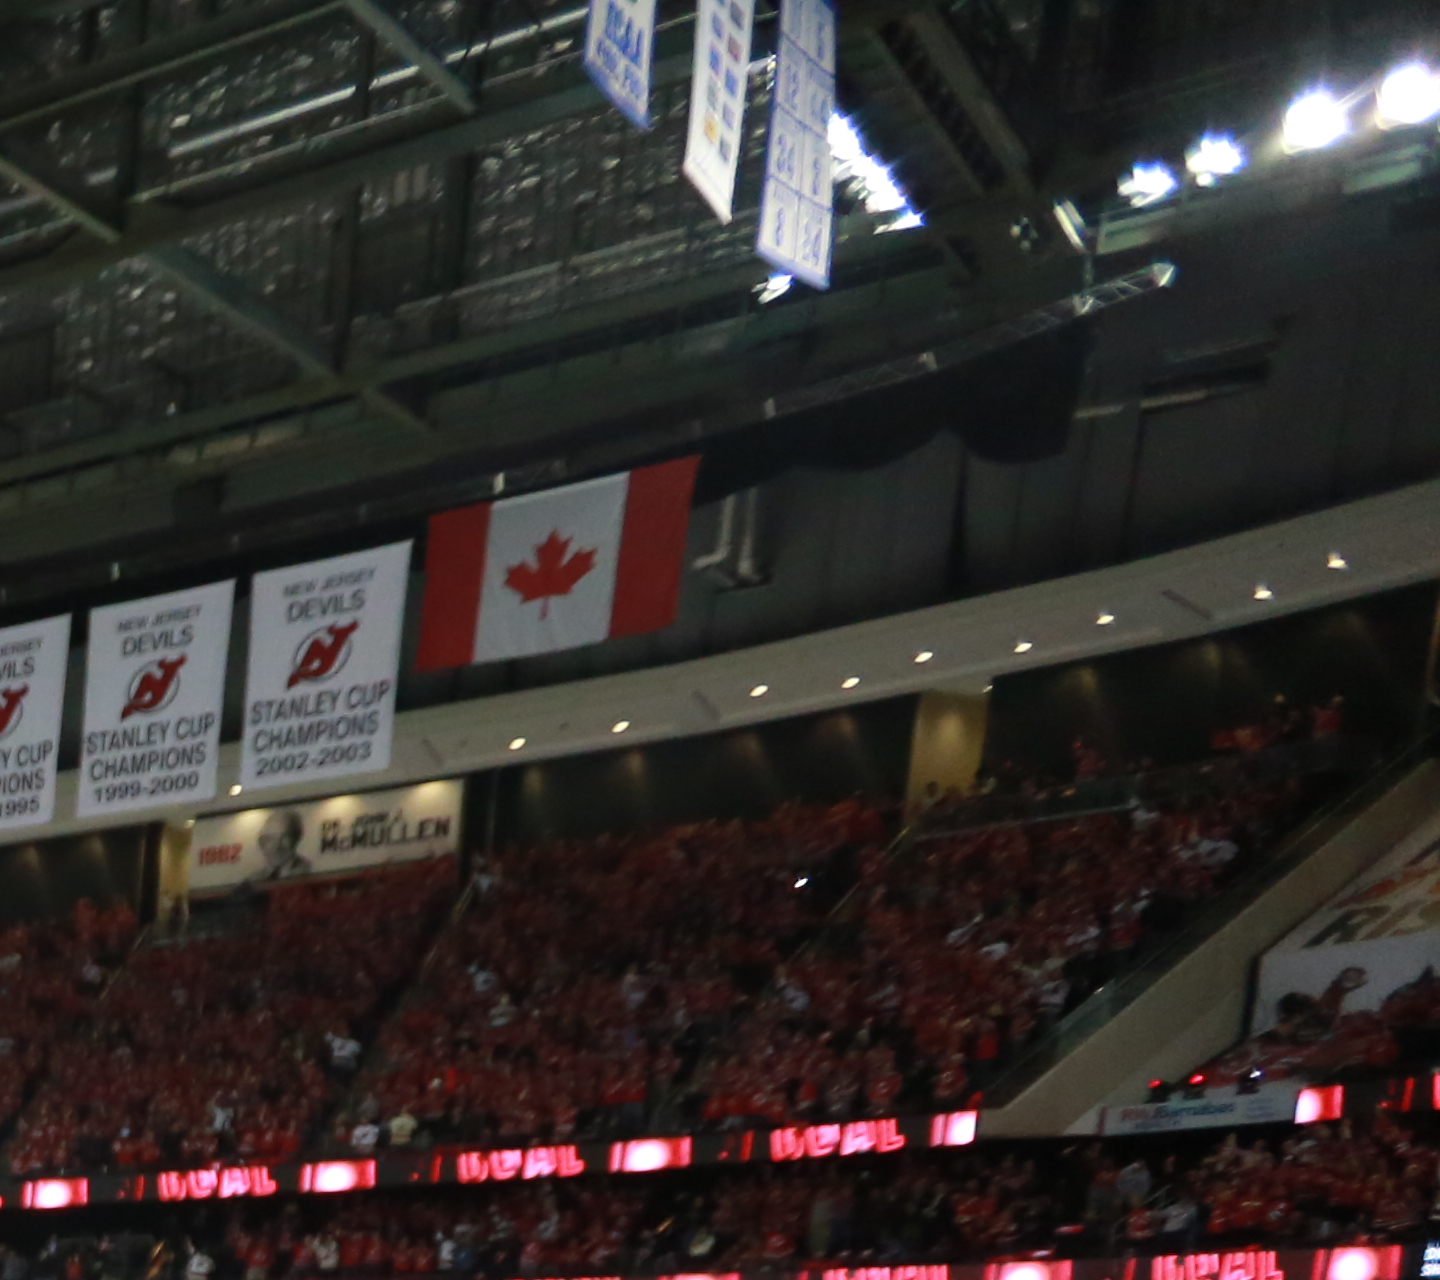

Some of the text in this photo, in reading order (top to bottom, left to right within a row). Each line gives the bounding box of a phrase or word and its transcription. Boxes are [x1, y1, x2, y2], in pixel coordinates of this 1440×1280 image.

[283, 566, 378, 597] NEW JERSEY
[116, 603, 205, 633] NEW JERSEY
[286, 588, 367, 624] DEVILS
[121, 624, 195, 657] DEVILS
[250, 679, 392, 726] STANLEY CUP
[86, 711, 216, 757] STANLEY CUP
[252, 709, 380, 754] CHAMPIONS
[16, 739, 54, 767] CUP
[90, 741, 208, 781] CHAMPIONS
[255, 741, 373, 778] 2002-2003
[93, 770, 200, 804] 1999-2000
